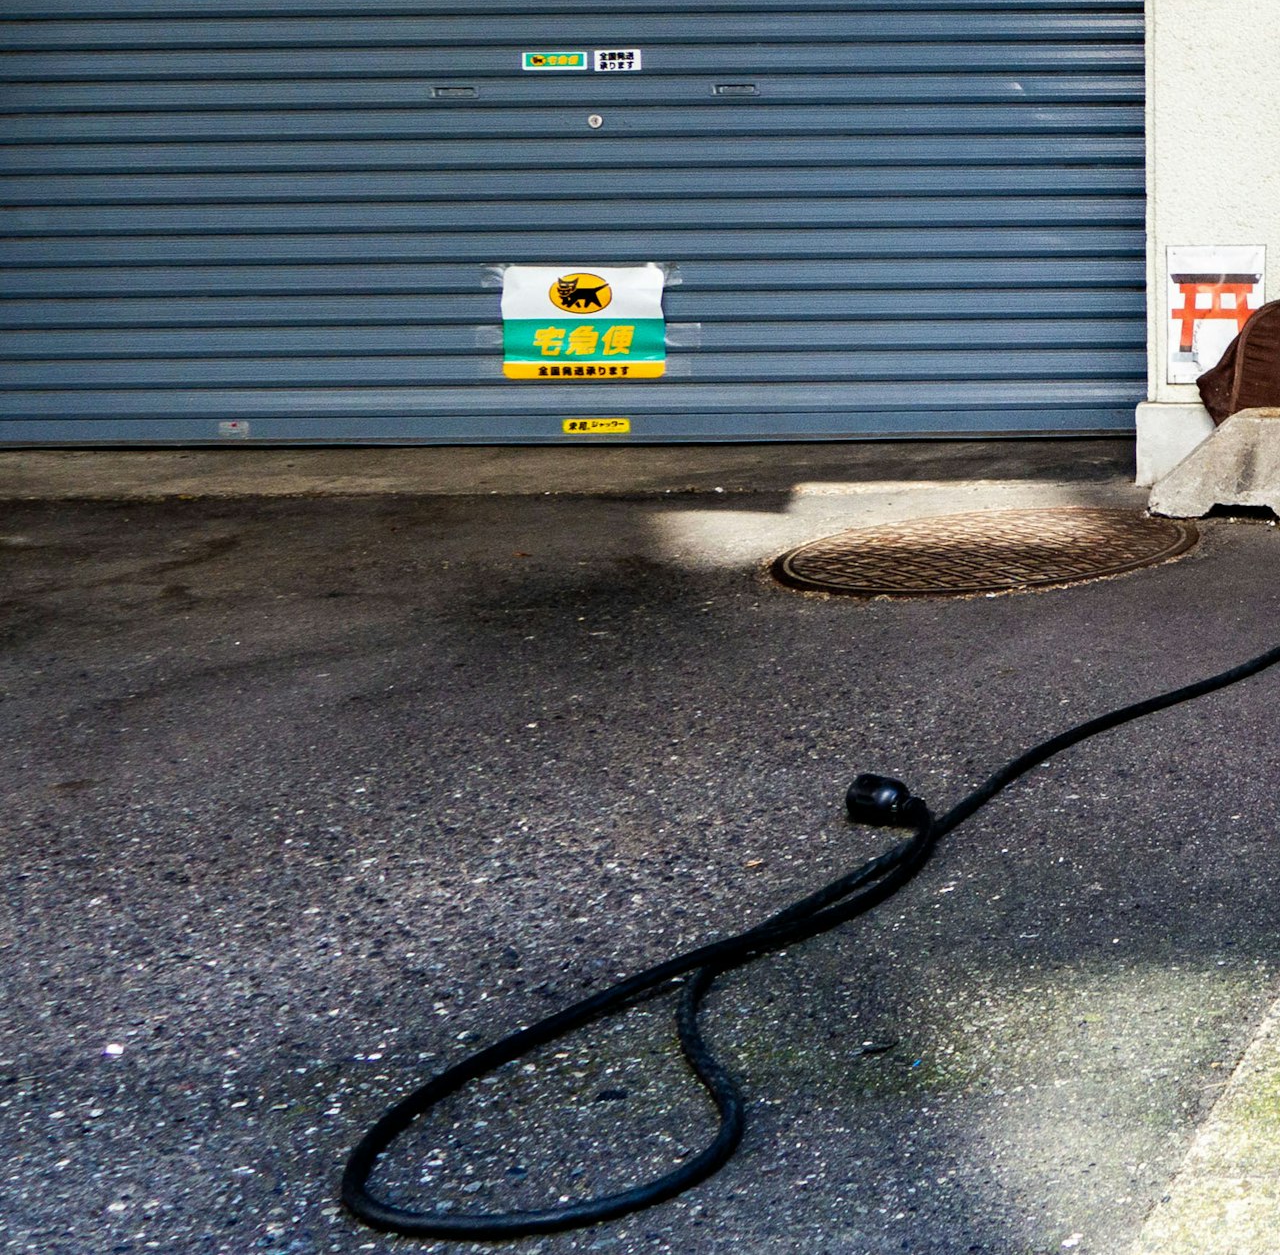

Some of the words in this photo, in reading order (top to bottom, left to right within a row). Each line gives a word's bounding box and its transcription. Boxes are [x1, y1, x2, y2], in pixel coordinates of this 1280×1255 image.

[533, 325, 636, 356] 宅急便
[538, 366, 630, 376] 全国発送承ります
